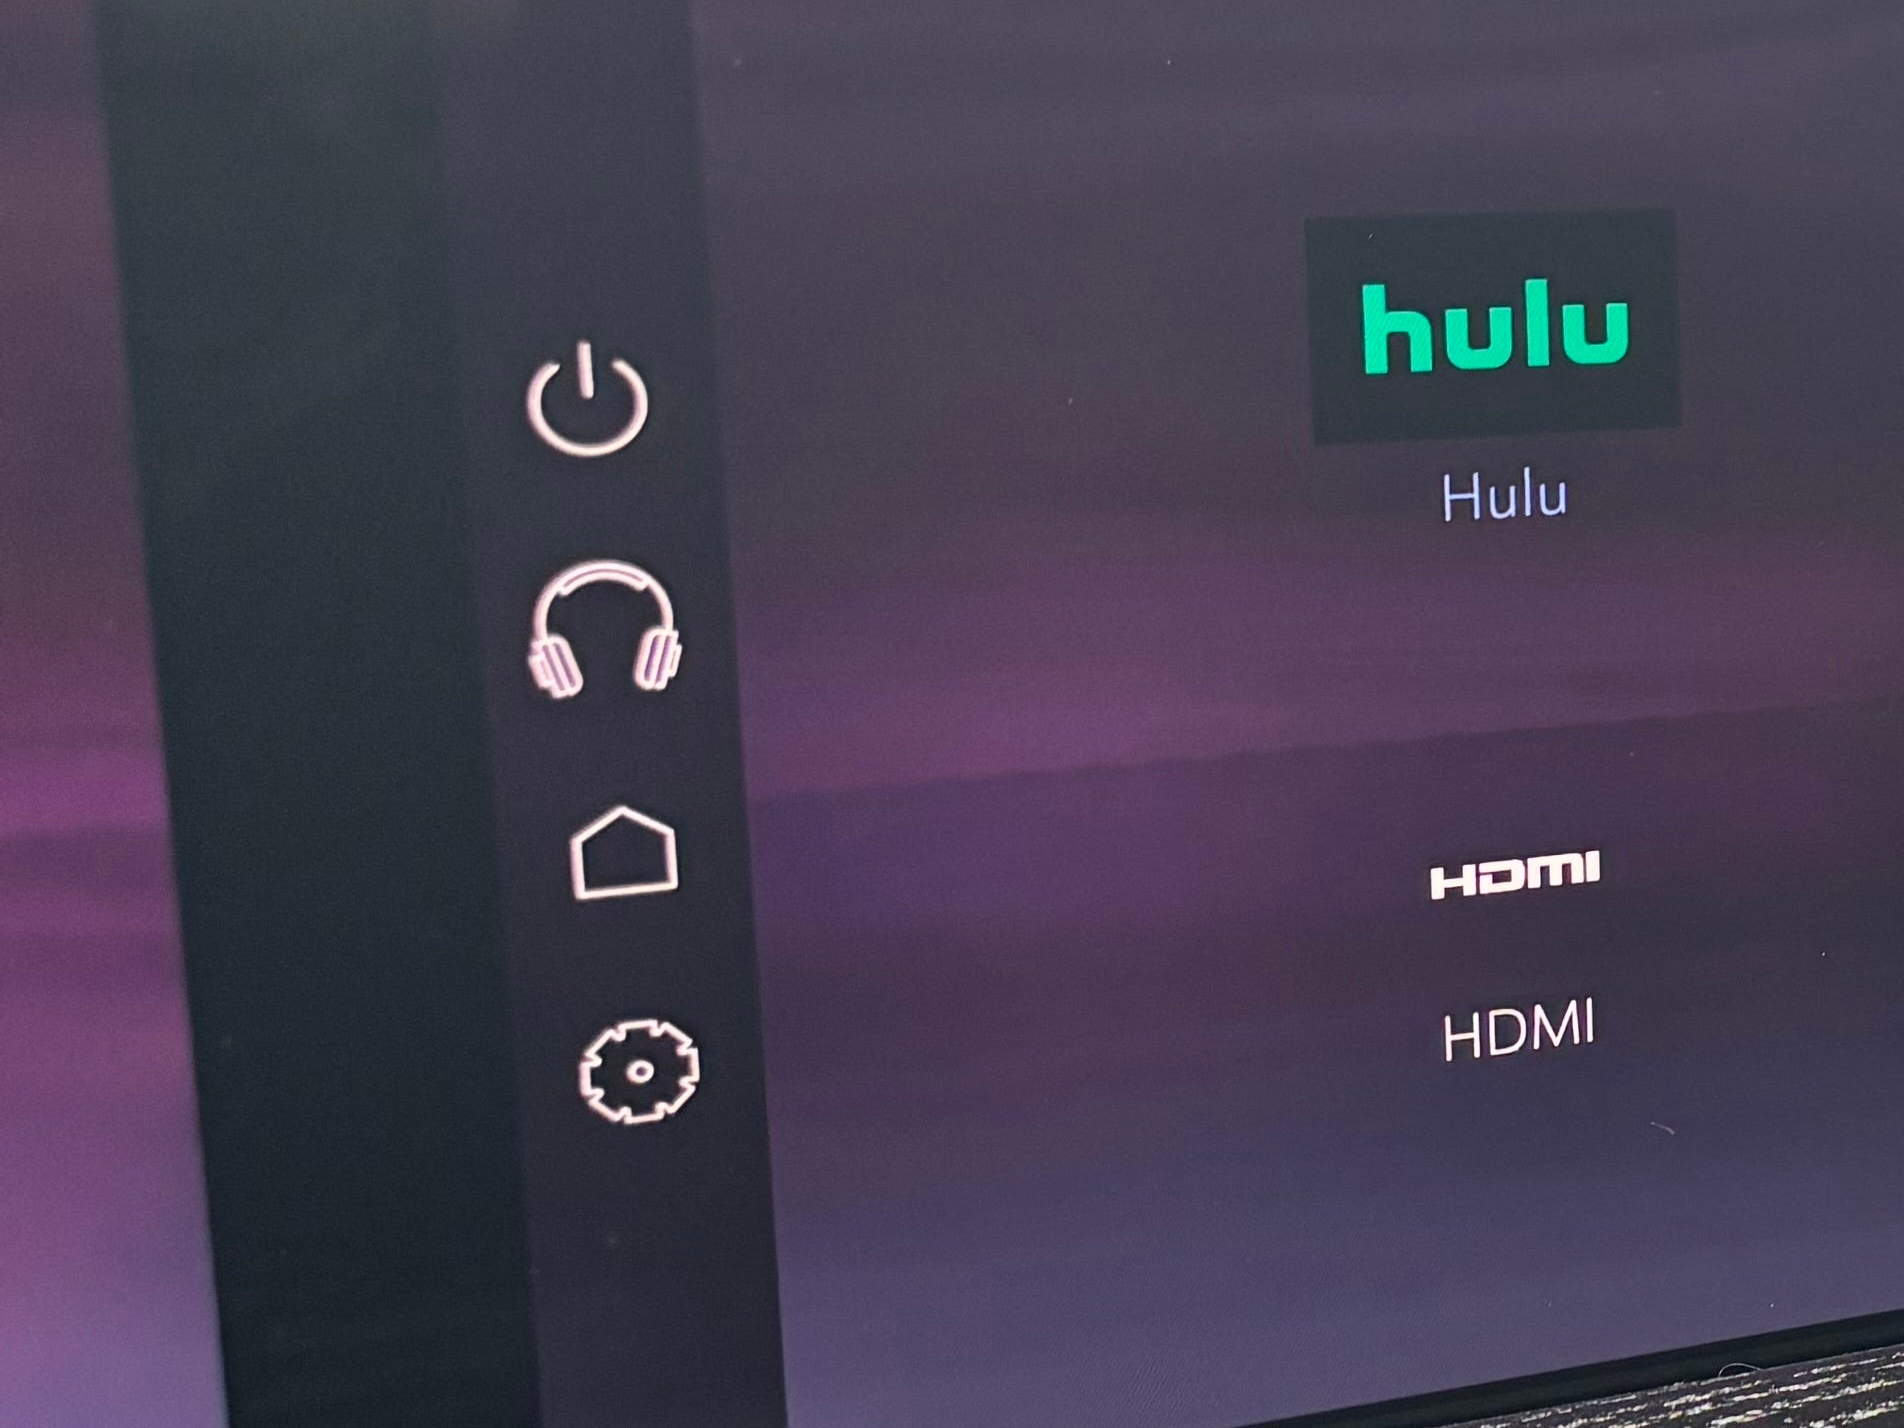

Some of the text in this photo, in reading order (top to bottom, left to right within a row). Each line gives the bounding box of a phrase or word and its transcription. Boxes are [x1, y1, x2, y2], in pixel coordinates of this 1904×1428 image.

[1362, 278, 1629, 375] hulu
[1443, 466, 1567, 522] Hulu
[1430, 850, 1601, 901] HDMI
[1444, 997, 1595, 1062] HDMI
